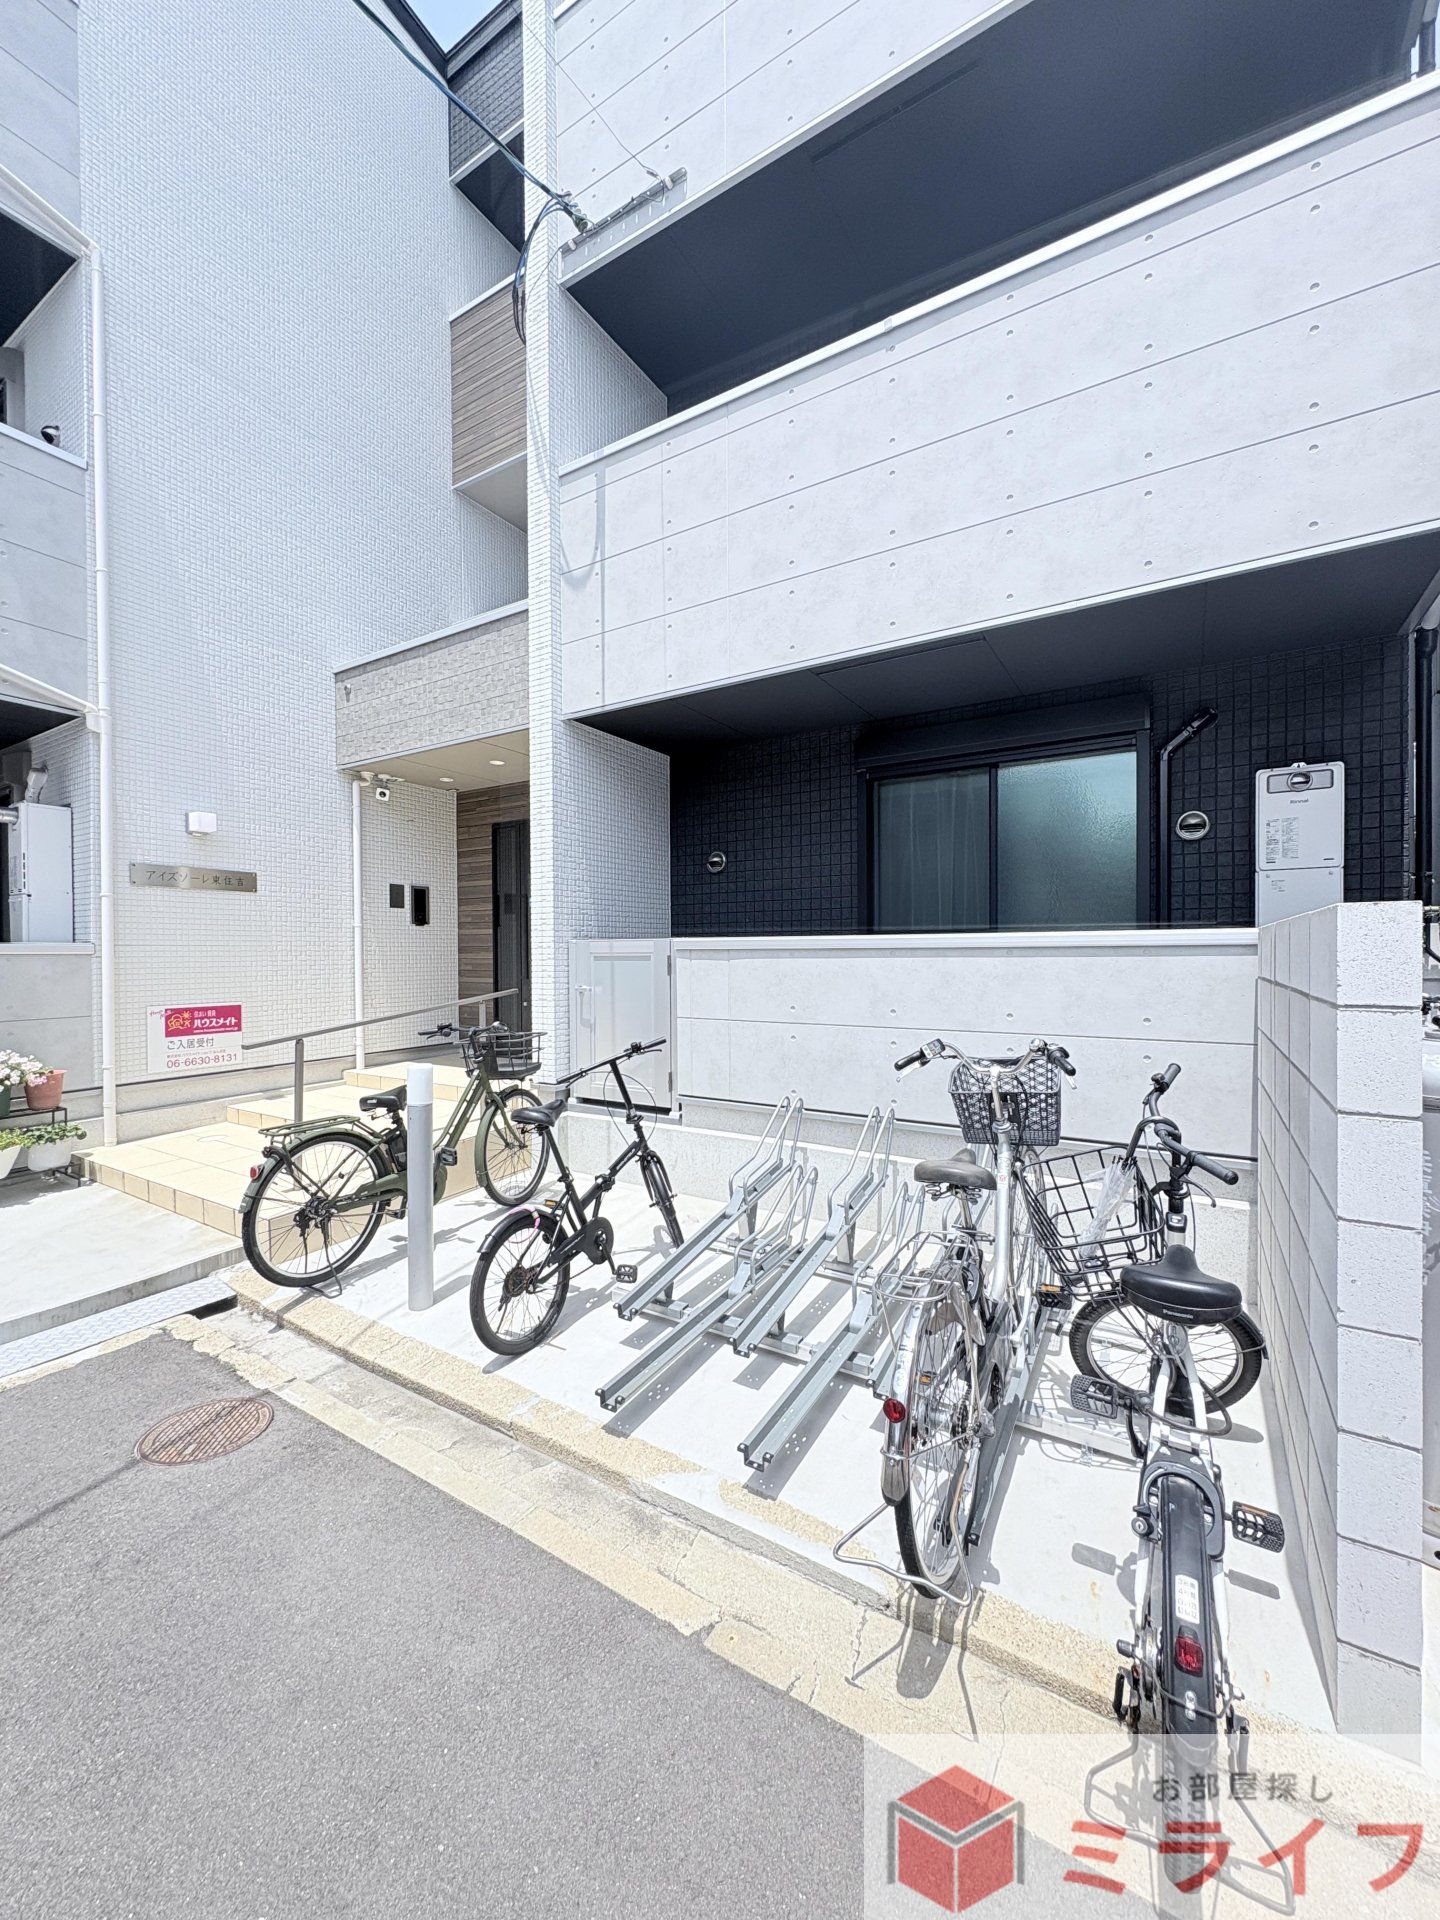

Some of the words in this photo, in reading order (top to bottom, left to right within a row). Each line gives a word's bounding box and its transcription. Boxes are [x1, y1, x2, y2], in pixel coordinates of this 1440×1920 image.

[193, 1016, 239, 1029] ハウスメイト
[167, 1037, 214, 1050] ご入居受付
[166, 1053, 237, 1069] 06-6630-8131
